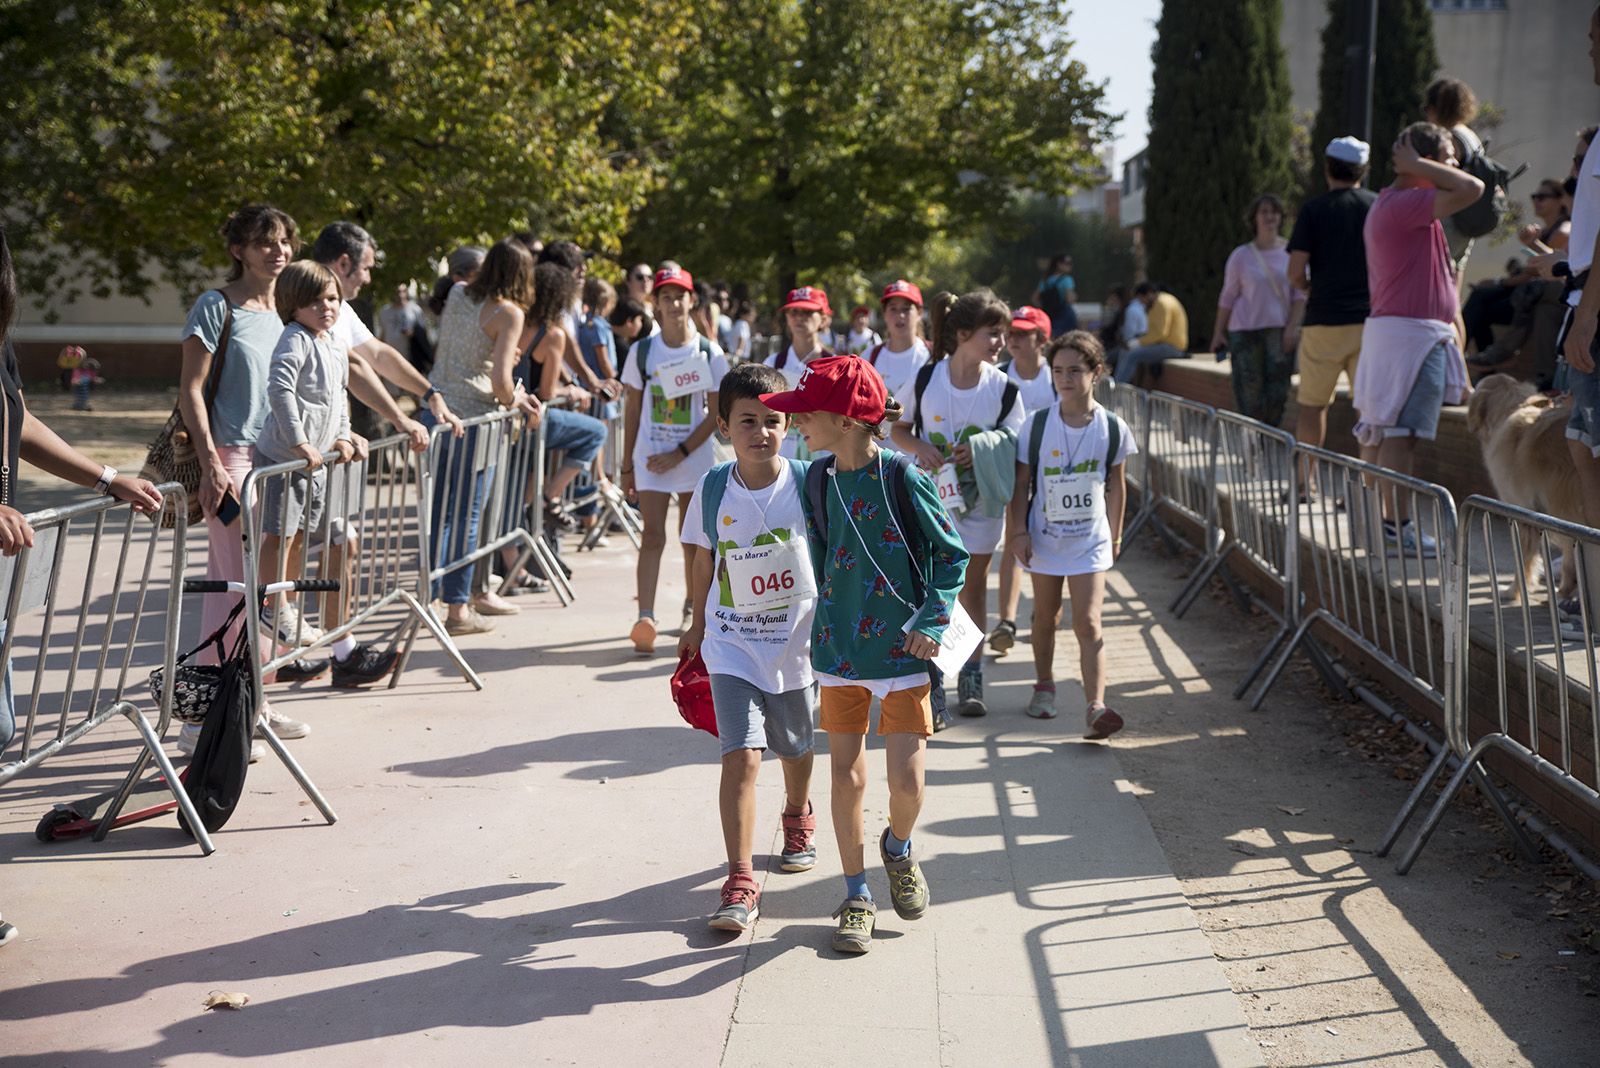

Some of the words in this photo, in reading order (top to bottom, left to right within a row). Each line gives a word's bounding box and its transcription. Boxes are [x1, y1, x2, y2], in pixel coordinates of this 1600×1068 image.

[674, 370, 700, 387] 096
[1062, 492, 1092, 509] 016
[751, 569, 795, 597] 046
[755, 613, 788, 626] Infantil
